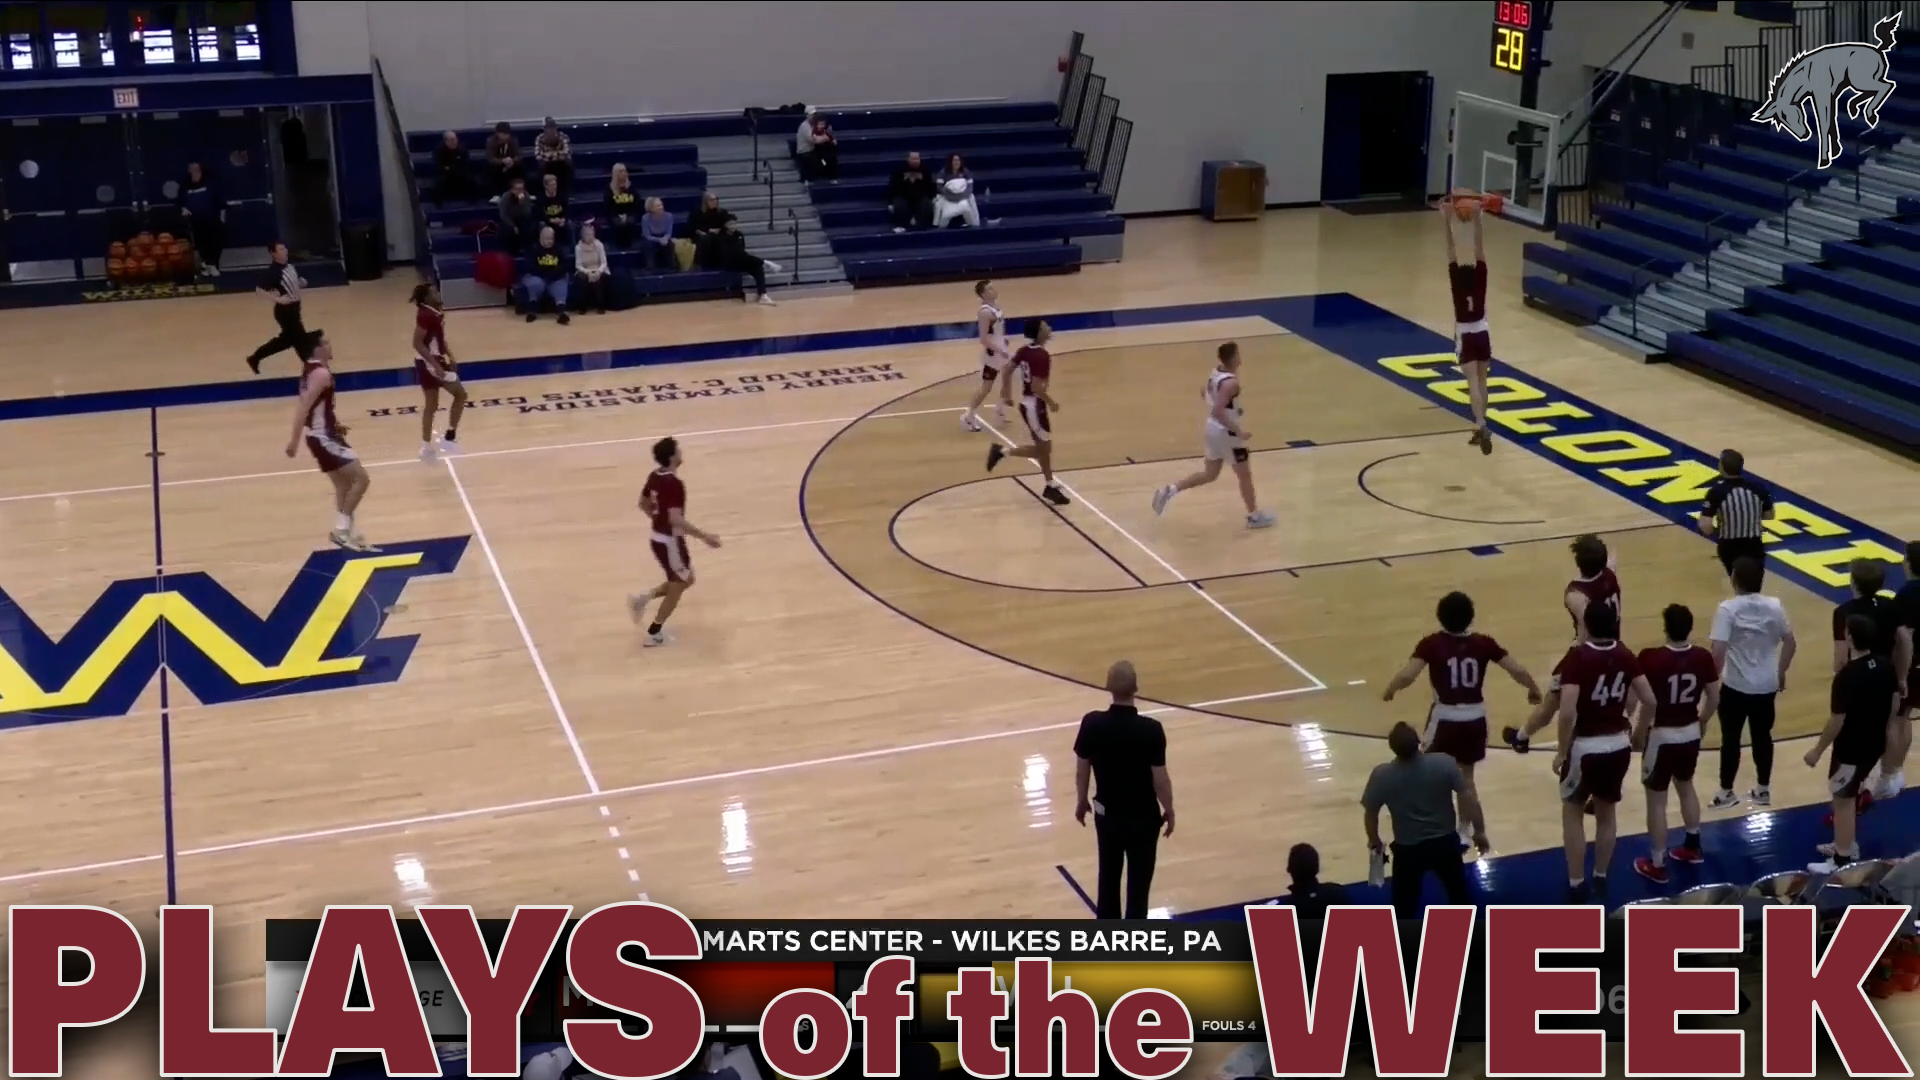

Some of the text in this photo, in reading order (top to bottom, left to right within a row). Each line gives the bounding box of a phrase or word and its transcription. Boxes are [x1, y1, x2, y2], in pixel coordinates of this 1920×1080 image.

[1495, 28, 1524, 71] 28
[117, 91, 135, 104] EXIT
[1466, 295, 1475, 312] 1
[691, 379, 725, 387] C.
[737, 363, 894, 384] ARNAUD
[516, 372, 908, 414] HENRY GYMNASIUM
[542, 382, 681, 401] MARTS
[1377, 352, 1905, 600] COLONEL
[1447, 656, 1479, 689] 10
[1590, 671, 1626, 707] 44
[1667, 672, 1698, 705] 12
